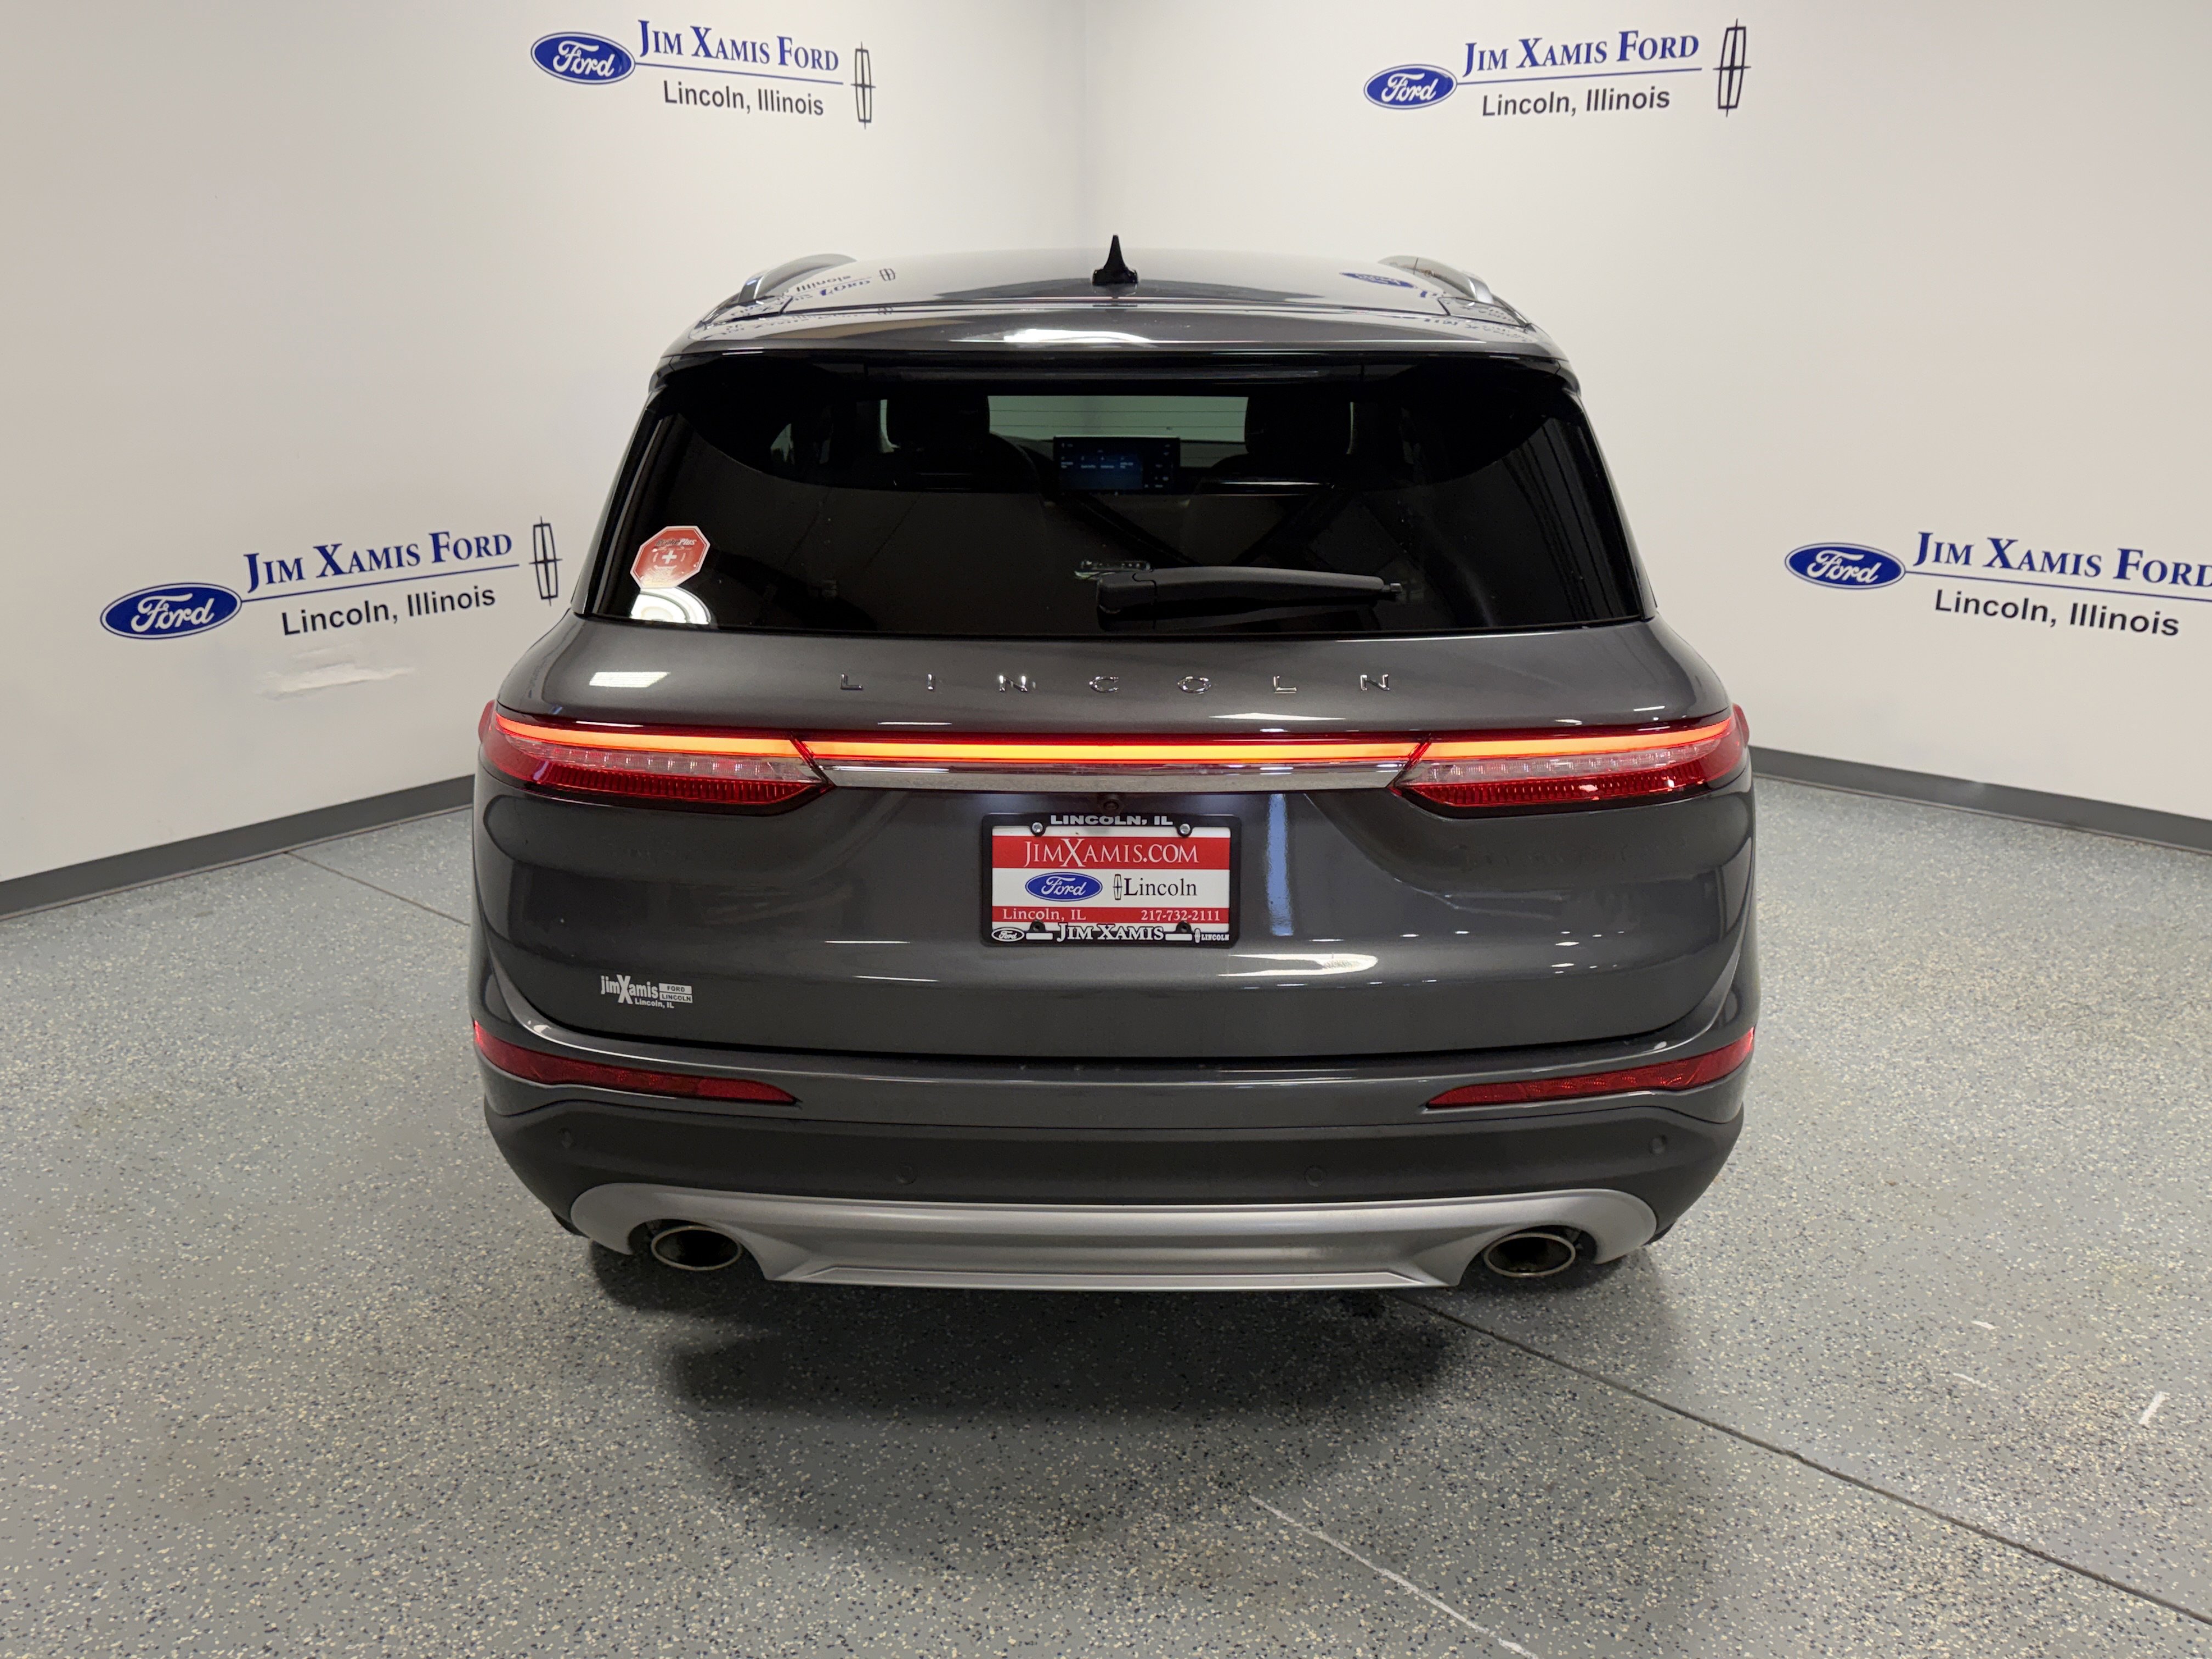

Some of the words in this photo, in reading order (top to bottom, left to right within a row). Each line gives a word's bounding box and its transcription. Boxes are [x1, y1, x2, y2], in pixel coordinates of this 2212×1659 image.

[552, 41, 615, 78] Ford
[1380, 68, 1438, 103] Ford
[663, 80, 751, 114] Lincoln,
[758, 89, 824, 116] Illinois
[1482, 91, 1577, 117] Lincoln,
[1585, 86, 1671, 111] Illinois
[1807, 549, 1878, 584] Ford
[130, 592, 215, 633] Ford
[281, 599, 399, 636] Lincoln,
[407, 585, 496, 617] Illinois
[1934, 589, 2058, 628] Lincoln,
[2069, 602, 2180, 636] Illinois
[839, 673, 1390, 693] LINCOLN
[1050, 815, 1148, 825] LINCOLN,
[1153, 815, 1173, 825] IL
[1041, 876, 1087, 896] Ford
[1124, 878, 1198, 896] Lincoln
[1002, 908, 1065, 921] Lincoln,
[1071, 910, 1086, 921] IL
[1141, 910, 1220, 921] 217-732-2111
[997, 930, 1018, 940] Ford
[1057, 923, 1094, 941] JIM
[1097, 924, 1164, 941] XAMIS
[634, 997, 665, 1008] Lincoln,
